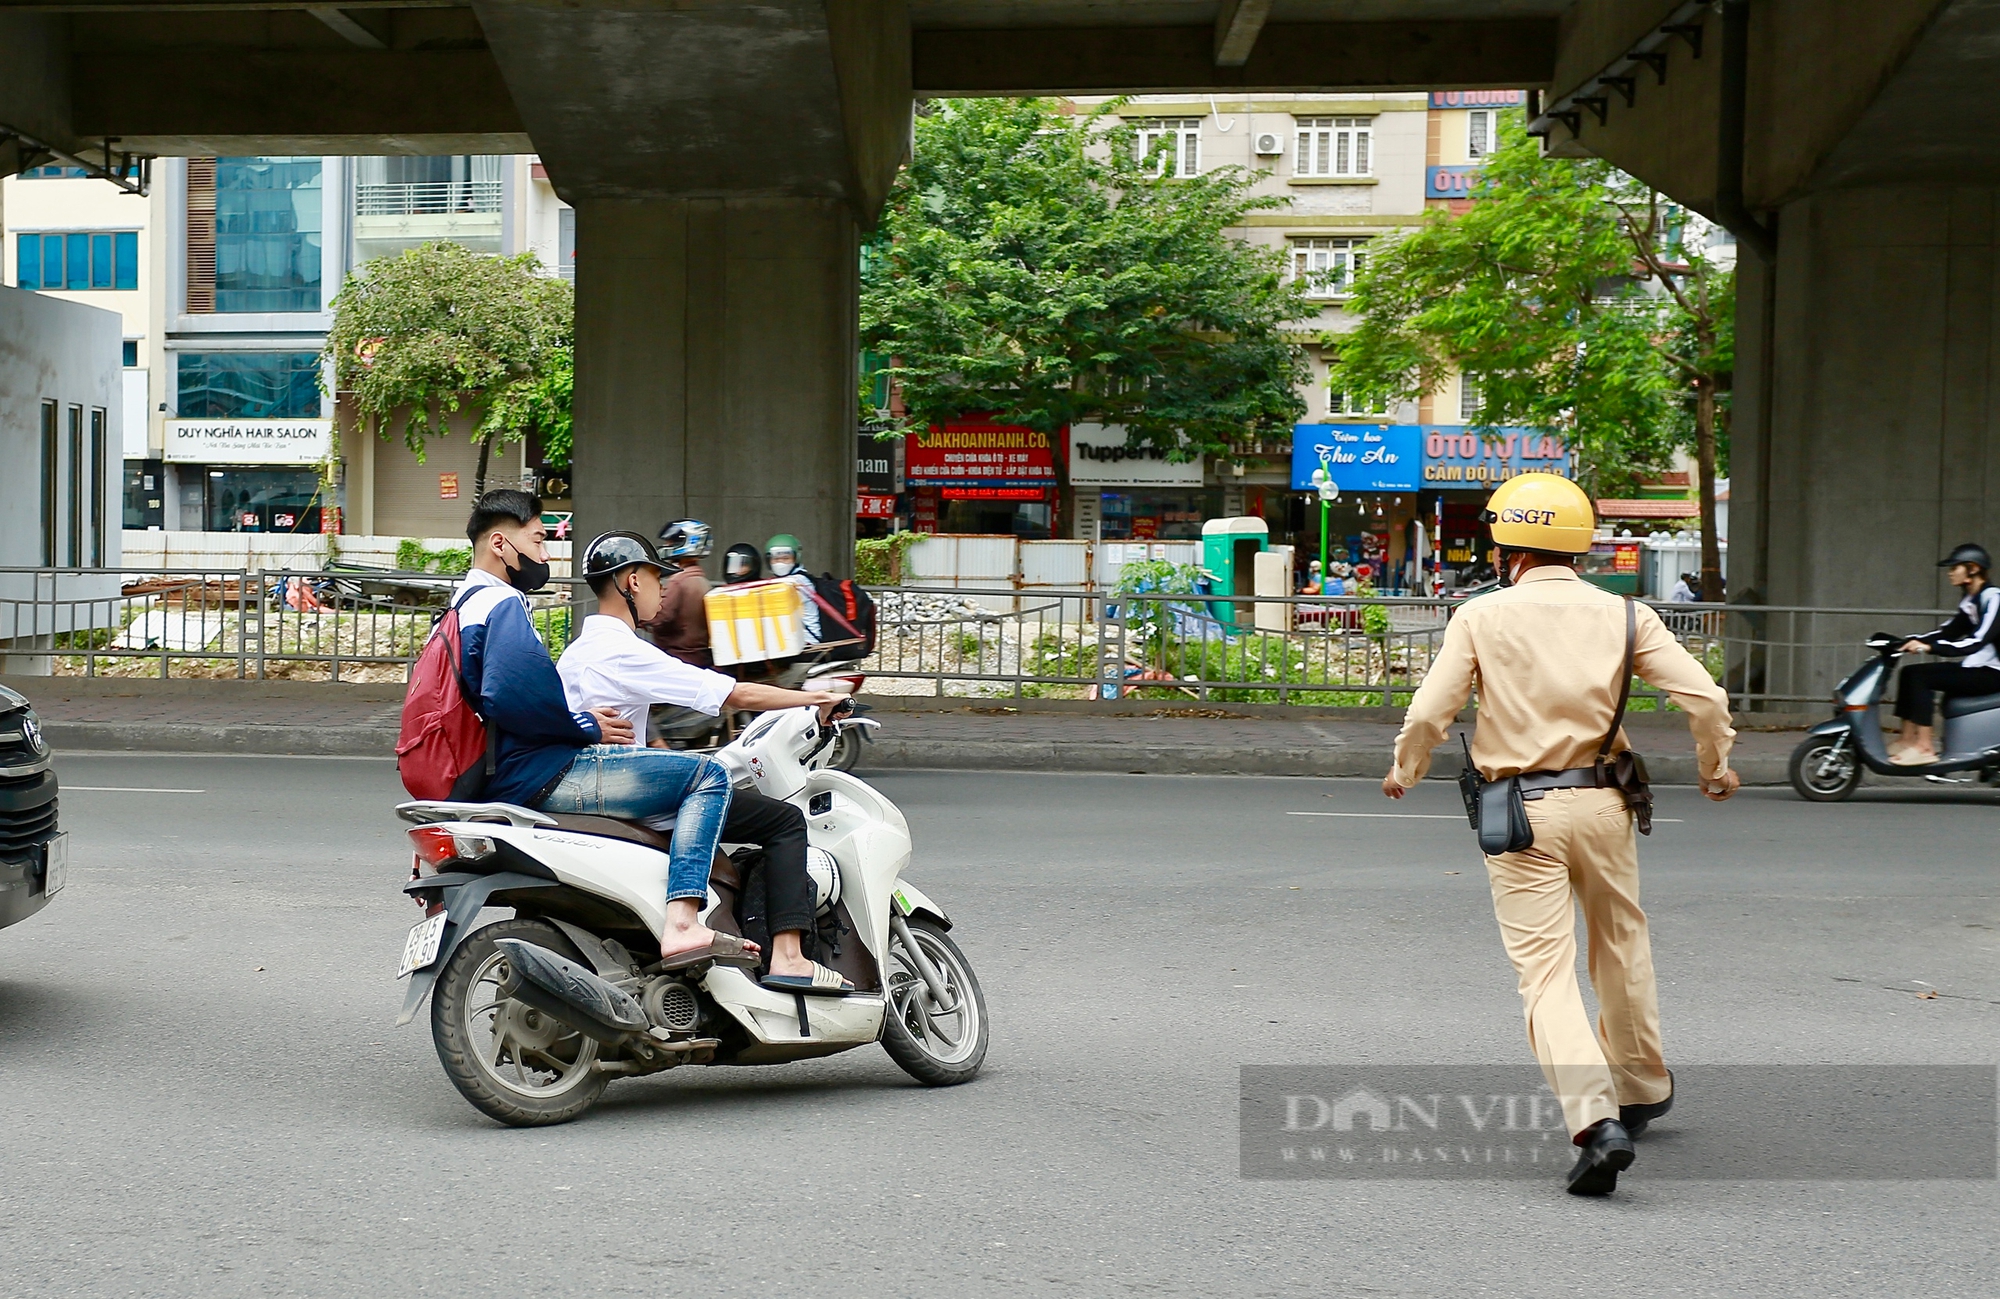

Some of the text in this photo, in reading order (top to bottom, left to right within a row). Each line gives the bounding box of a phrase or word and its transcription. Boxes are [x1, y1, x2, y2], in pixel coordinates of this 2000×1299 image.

[177, 425, 317, 438] DUY NGHĨA HAIR SALON
[1331, 430, 1383, 444] Tiệm hoa
[1426, 430, 1478, 459] ÔTÔ
[1313, 443, 1399, 464] Thu An
[1501, 508, 1555, 526] CSGT
[533, 833, 606, 849] VISION
